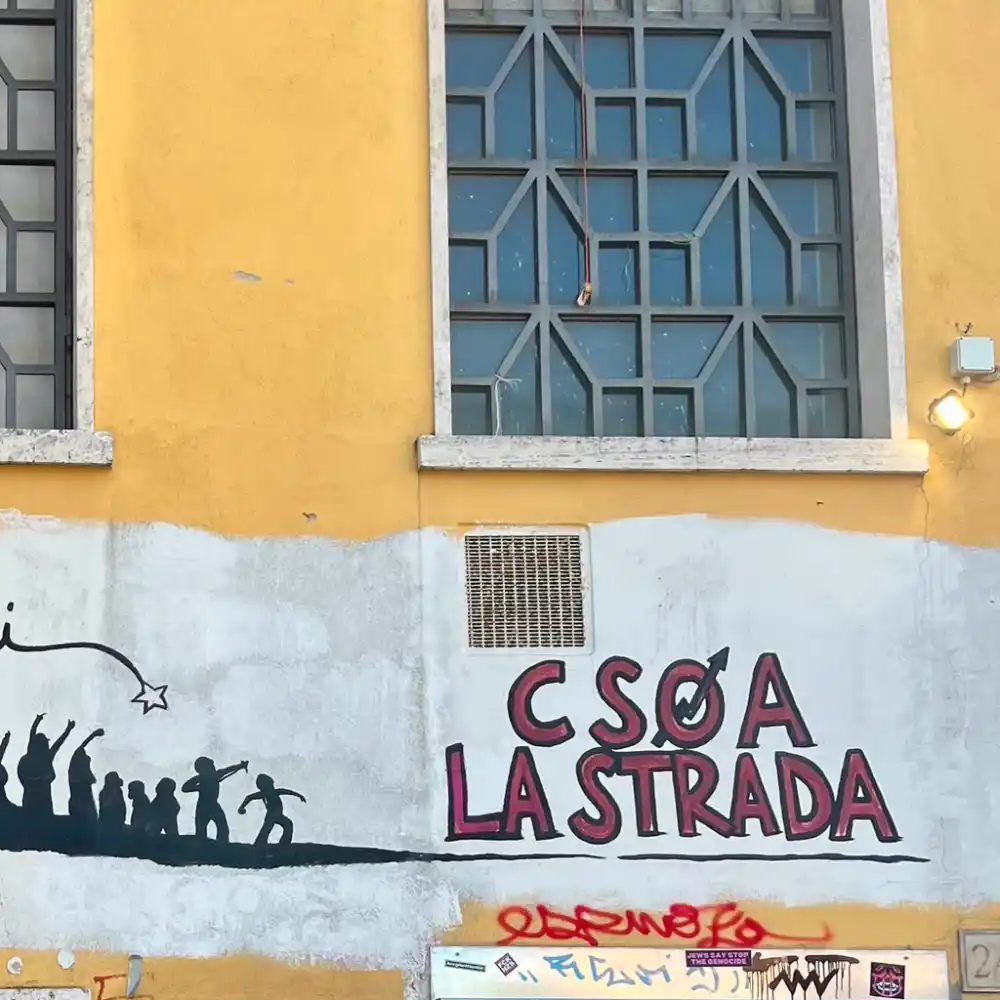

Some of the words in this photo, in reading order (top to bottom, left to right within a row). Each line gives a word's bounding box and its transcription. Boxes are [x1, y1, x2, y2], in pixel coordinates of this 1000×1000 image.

[507, 646, 817, 749] CSOA
[445, 743, 566, 841] LA
[568, 747, 903, 845] STRADA
[727, 951, 748, 959] STOP
